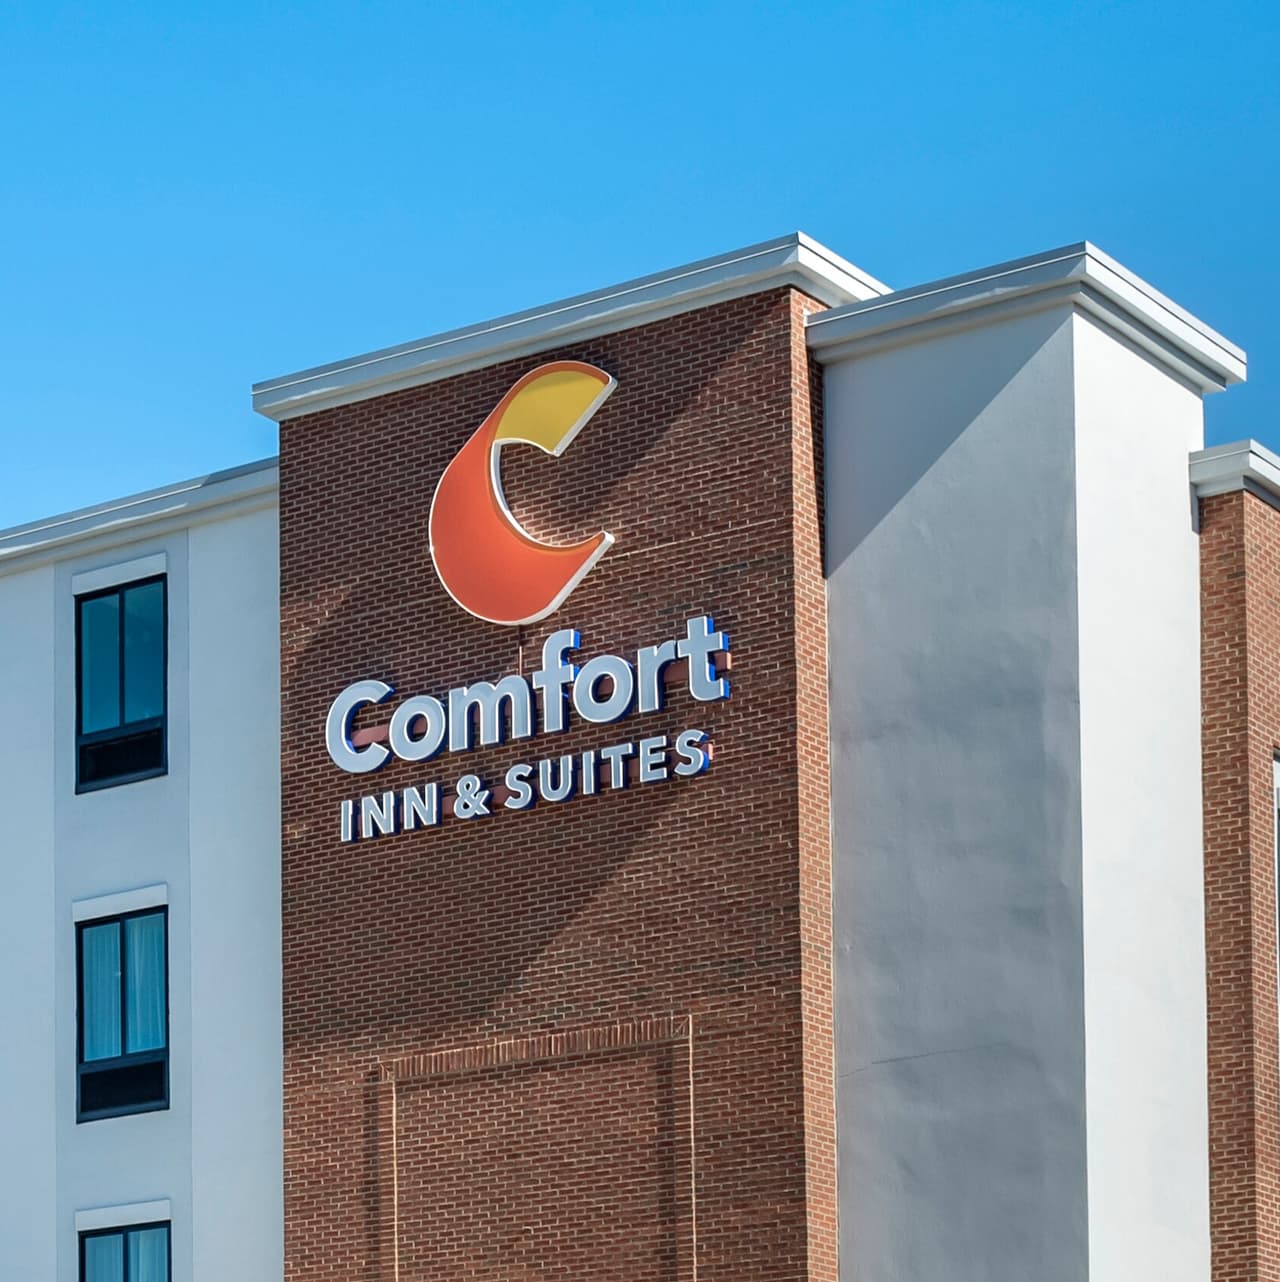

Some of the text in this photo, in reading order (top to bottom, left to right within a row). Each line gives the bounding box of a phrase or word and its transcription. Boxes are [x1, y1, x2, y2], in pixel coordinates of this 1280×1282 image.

[325, 615, 730, 774] Comfort
[340, 729, 710, 842] INN & SUITES
